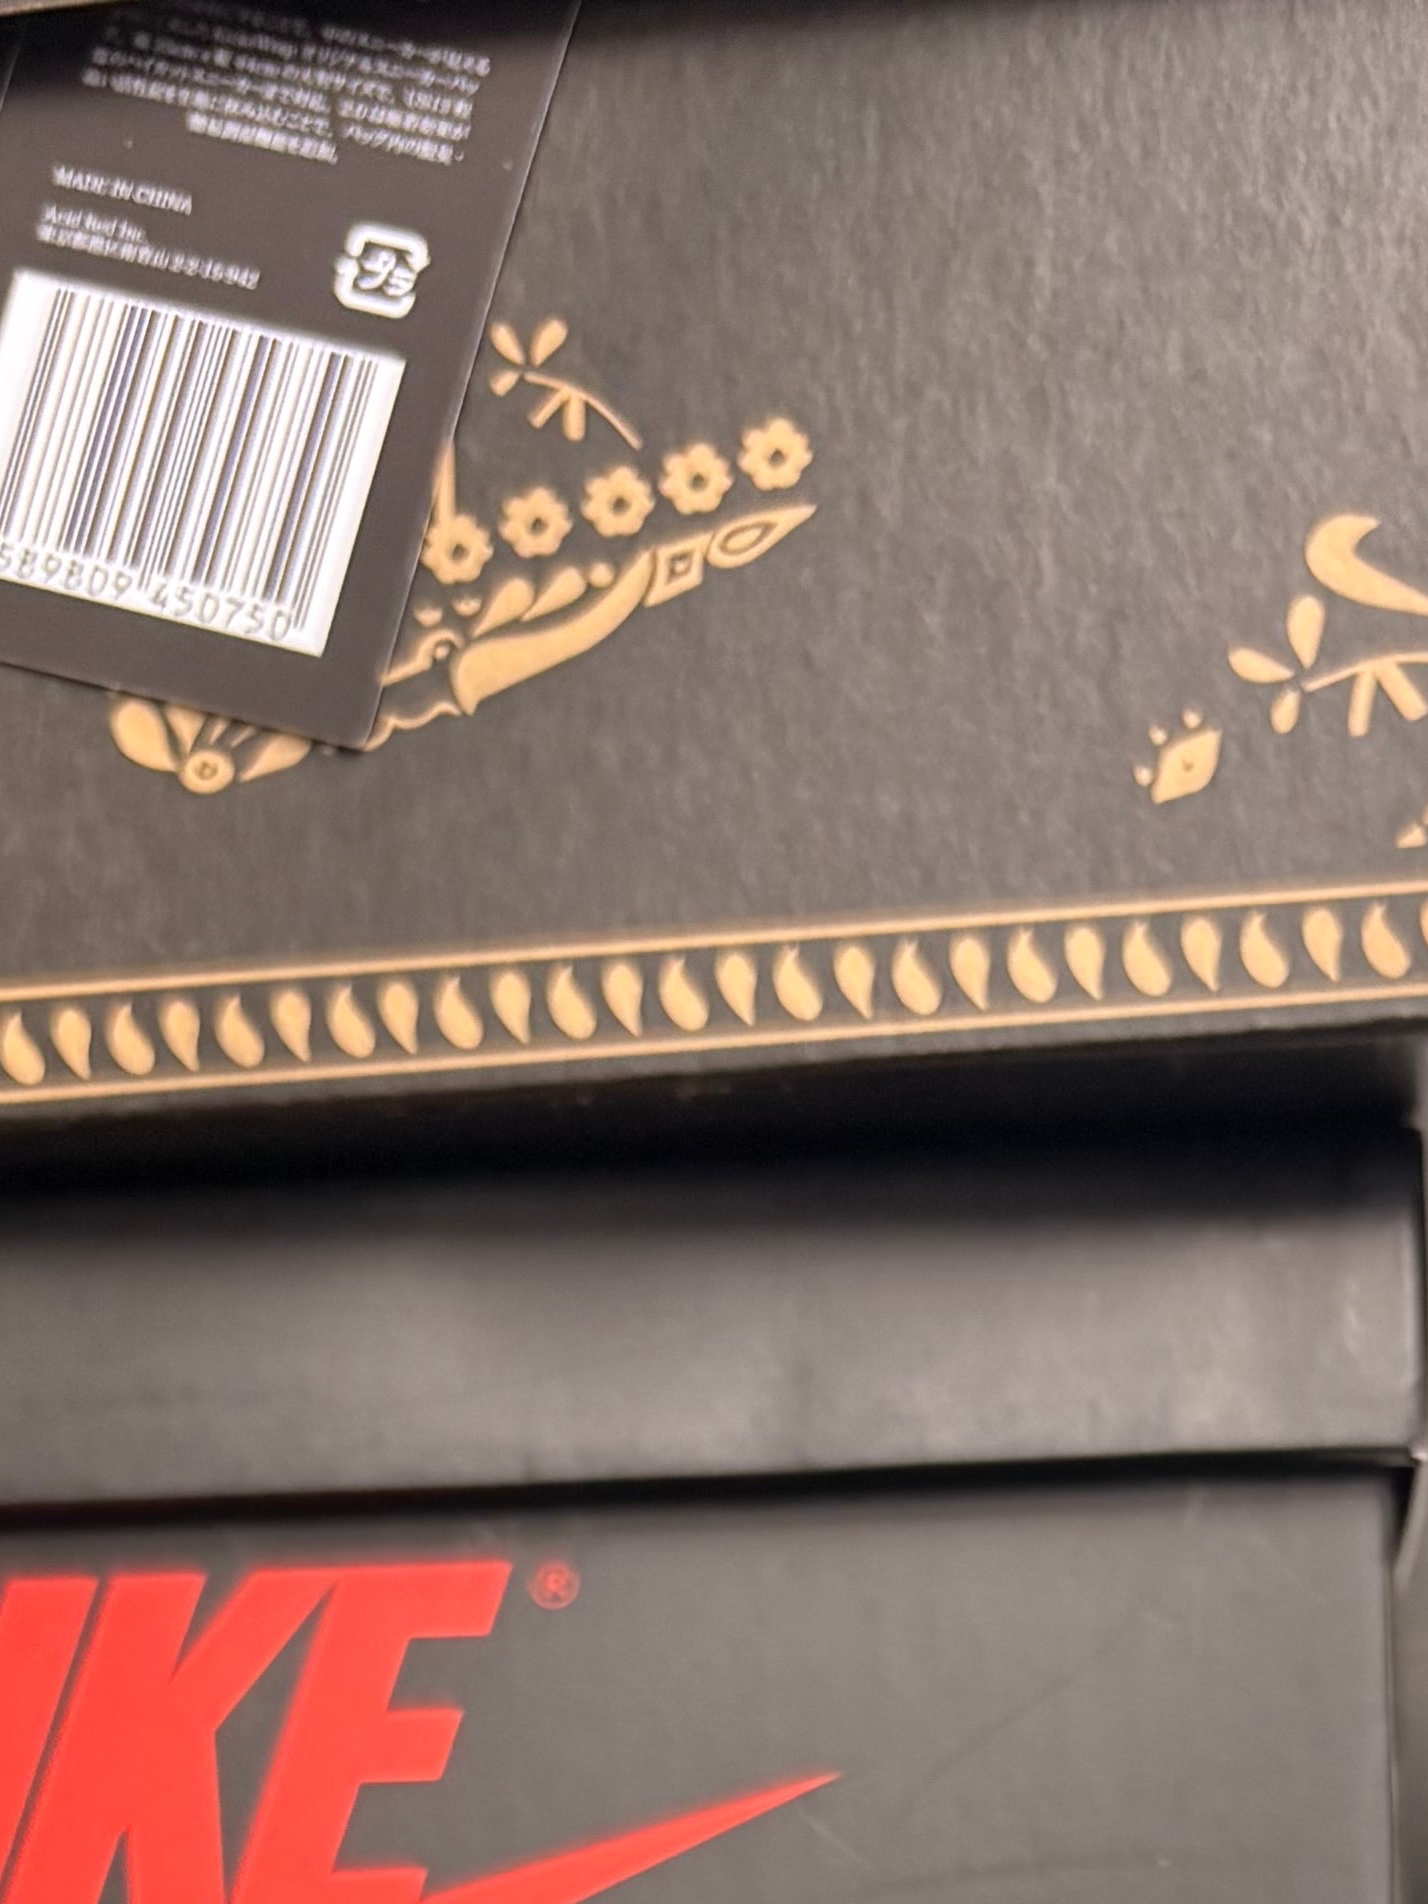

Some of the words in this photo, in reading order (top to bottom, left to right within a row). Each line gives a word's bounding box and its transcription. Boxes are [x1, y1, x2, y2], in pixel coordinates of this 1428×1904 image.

[110, 176, 134, 201] IN
[132, 183, 193, 216] CHINA
[148, 574, 294, 642] 450750
